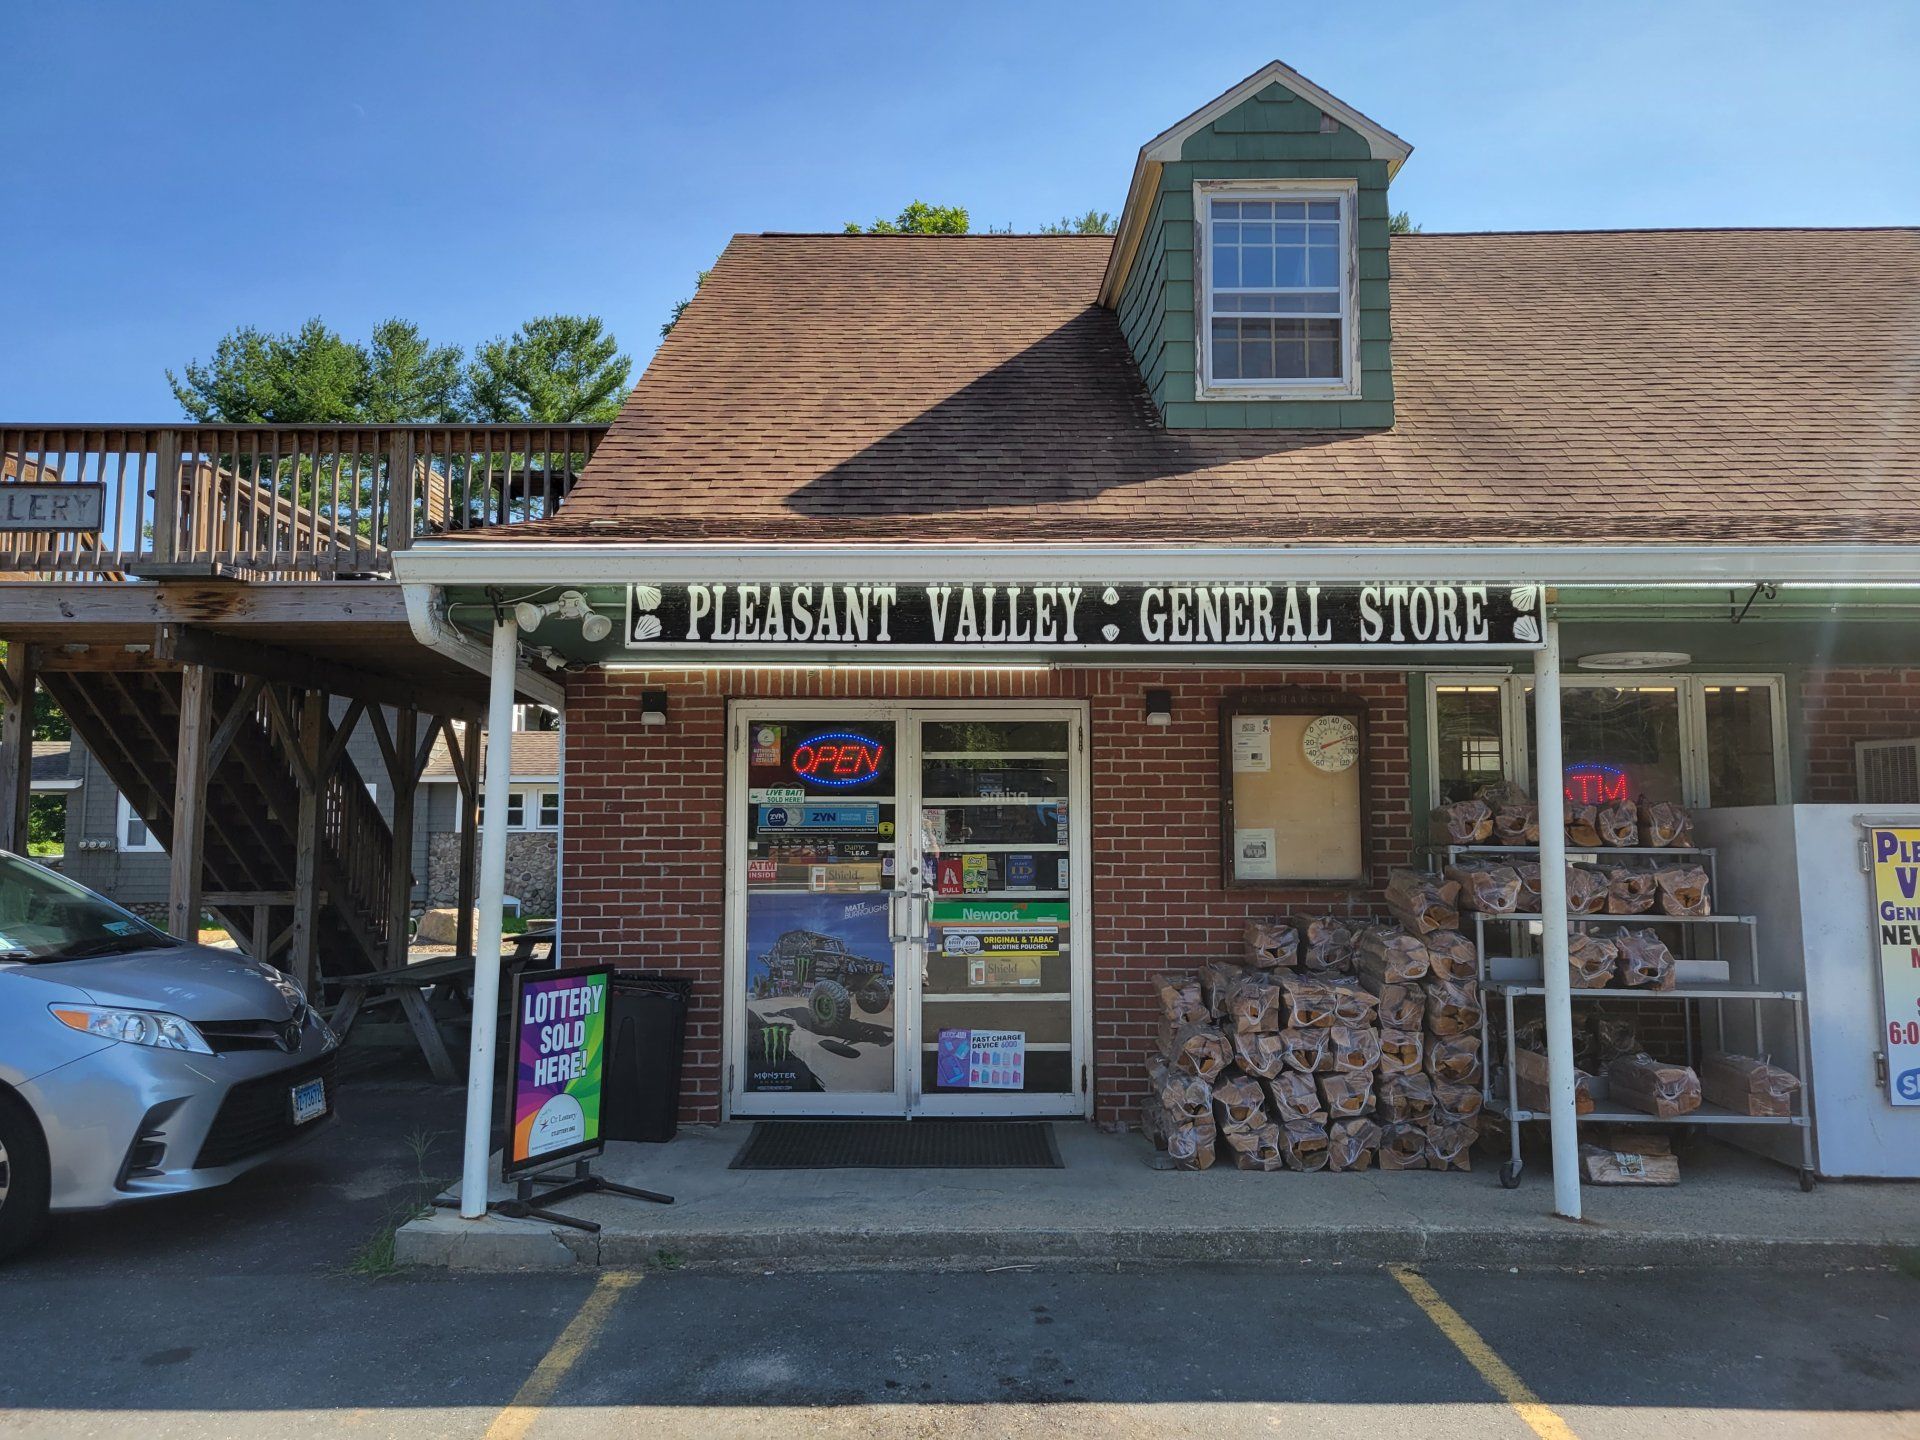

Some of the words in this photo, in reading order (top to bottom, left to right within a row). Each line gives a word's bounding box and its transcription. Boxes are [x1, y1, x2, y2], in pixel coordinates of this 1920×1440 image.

[687, 585, 897, 641] PLEASANT
[926, 585, 1083, 642] VALLEY
[1140, 585, 1333, 643] GENERAL
[1359, 585, 1489, 643] STORE
[792, 746, 883, 773] OPEN
[770, 811, 785, 821] ZYN
[812, 812, 837, 822] ZYN
[749, 861, 776, 871] ATM
[749, 871, 776, 879] INSIDE
[829, 869, 859, 881] Shield
[844, 902, 865, 913] MATT
[844, 904, 889, 920] BURROUGHS
[1880, 901, 1920, 921] GEN
[963, 908, 1019, 922] Newport
[983, 936, 1020, 944] ORIGINAL
[988, 963, 1017, 974] Shield
[524, 985, 603, 1025] LOTTERY
[541, 1021, 585, 1054] SOLD
[534, 1050, 587, 1088] HERE!
[754, 1072, 798, 1080] MONSTER
